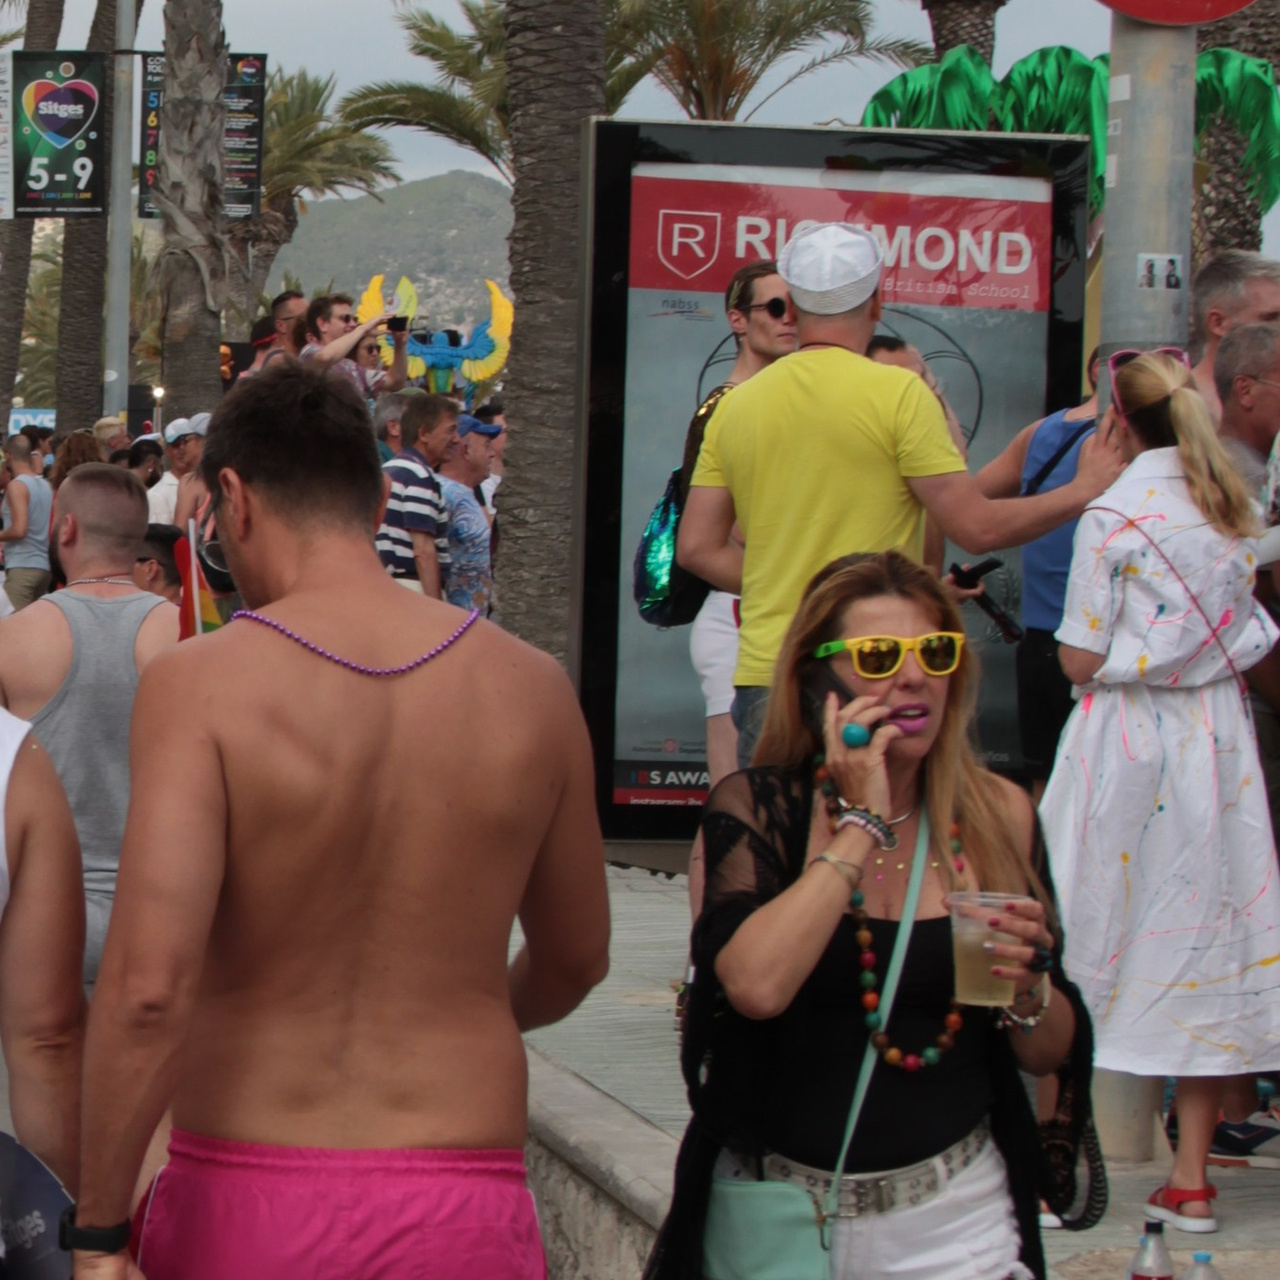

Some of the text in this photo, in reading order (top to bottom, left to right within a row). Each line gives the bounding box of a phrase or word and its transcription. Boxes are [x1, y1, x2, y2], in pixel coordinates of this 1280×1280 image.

[147, 92, 158, 108] 5
[38, 101, 84, 118] Sitges
[147, 111, 158, 128] 6
[147, 130, 158, 147] 7
[145, 150, 157, 167] 8
[671, 223, 706, 259] R
[734, 216, 1033, 275] RIMOND
[883, 278, 1031, 300] British School
[661, 297, 700, 311] nabss
